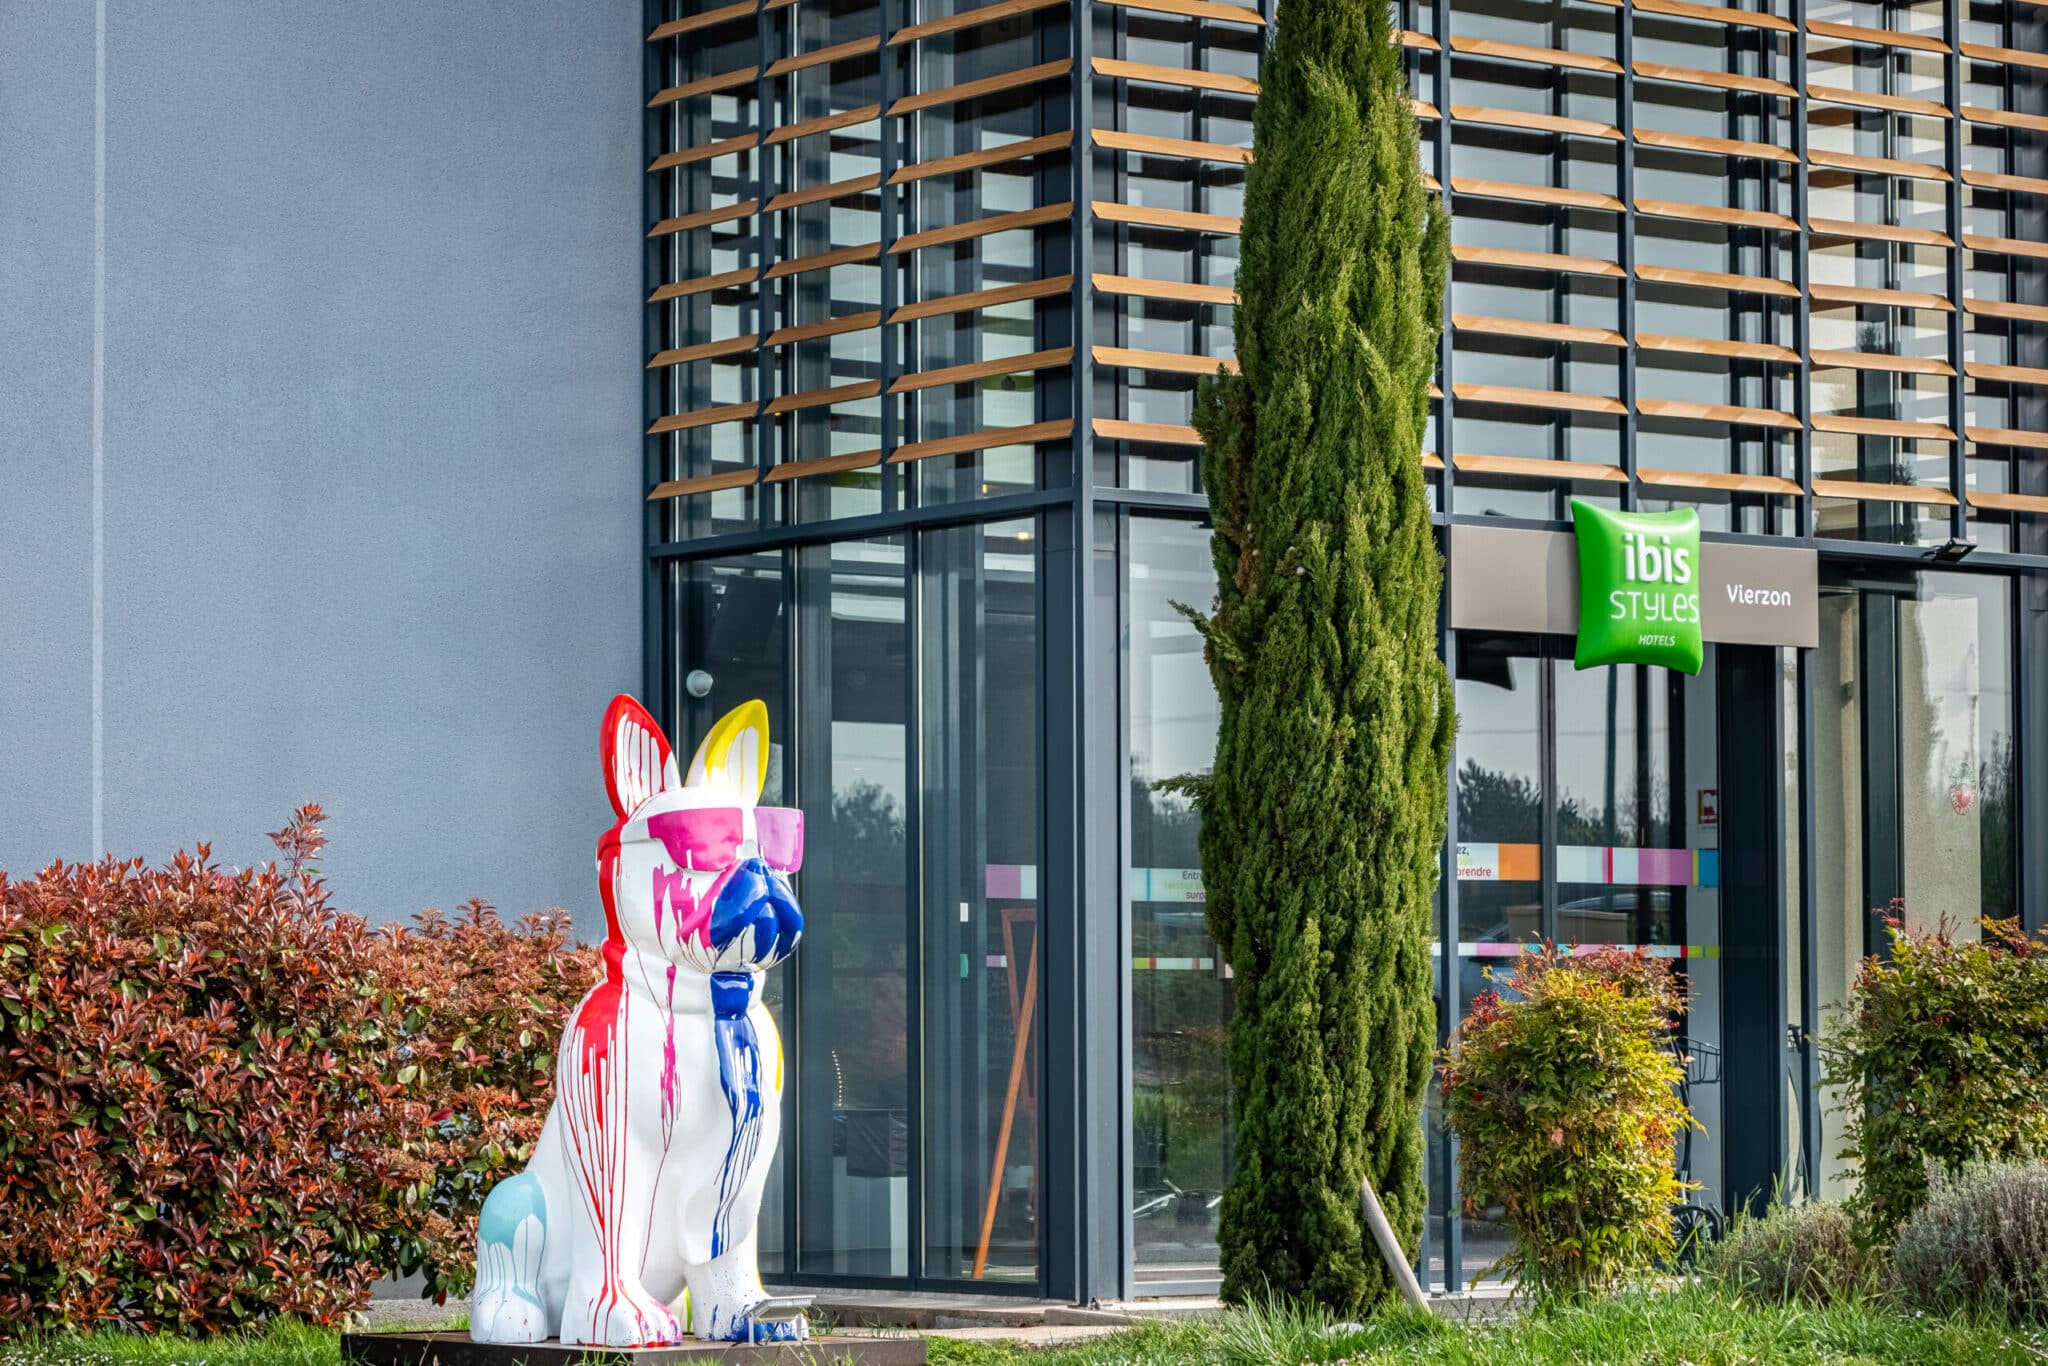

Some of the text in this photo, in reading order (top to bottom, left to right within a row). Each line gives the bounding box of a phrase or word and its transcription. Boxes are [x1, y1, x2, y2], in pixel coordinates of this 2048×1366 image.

[1624, 532, 1691, 584] ibis
[1726, 583, 1792, 607] Vierzon
[1638, 634, 1676, 647] HOTELS
